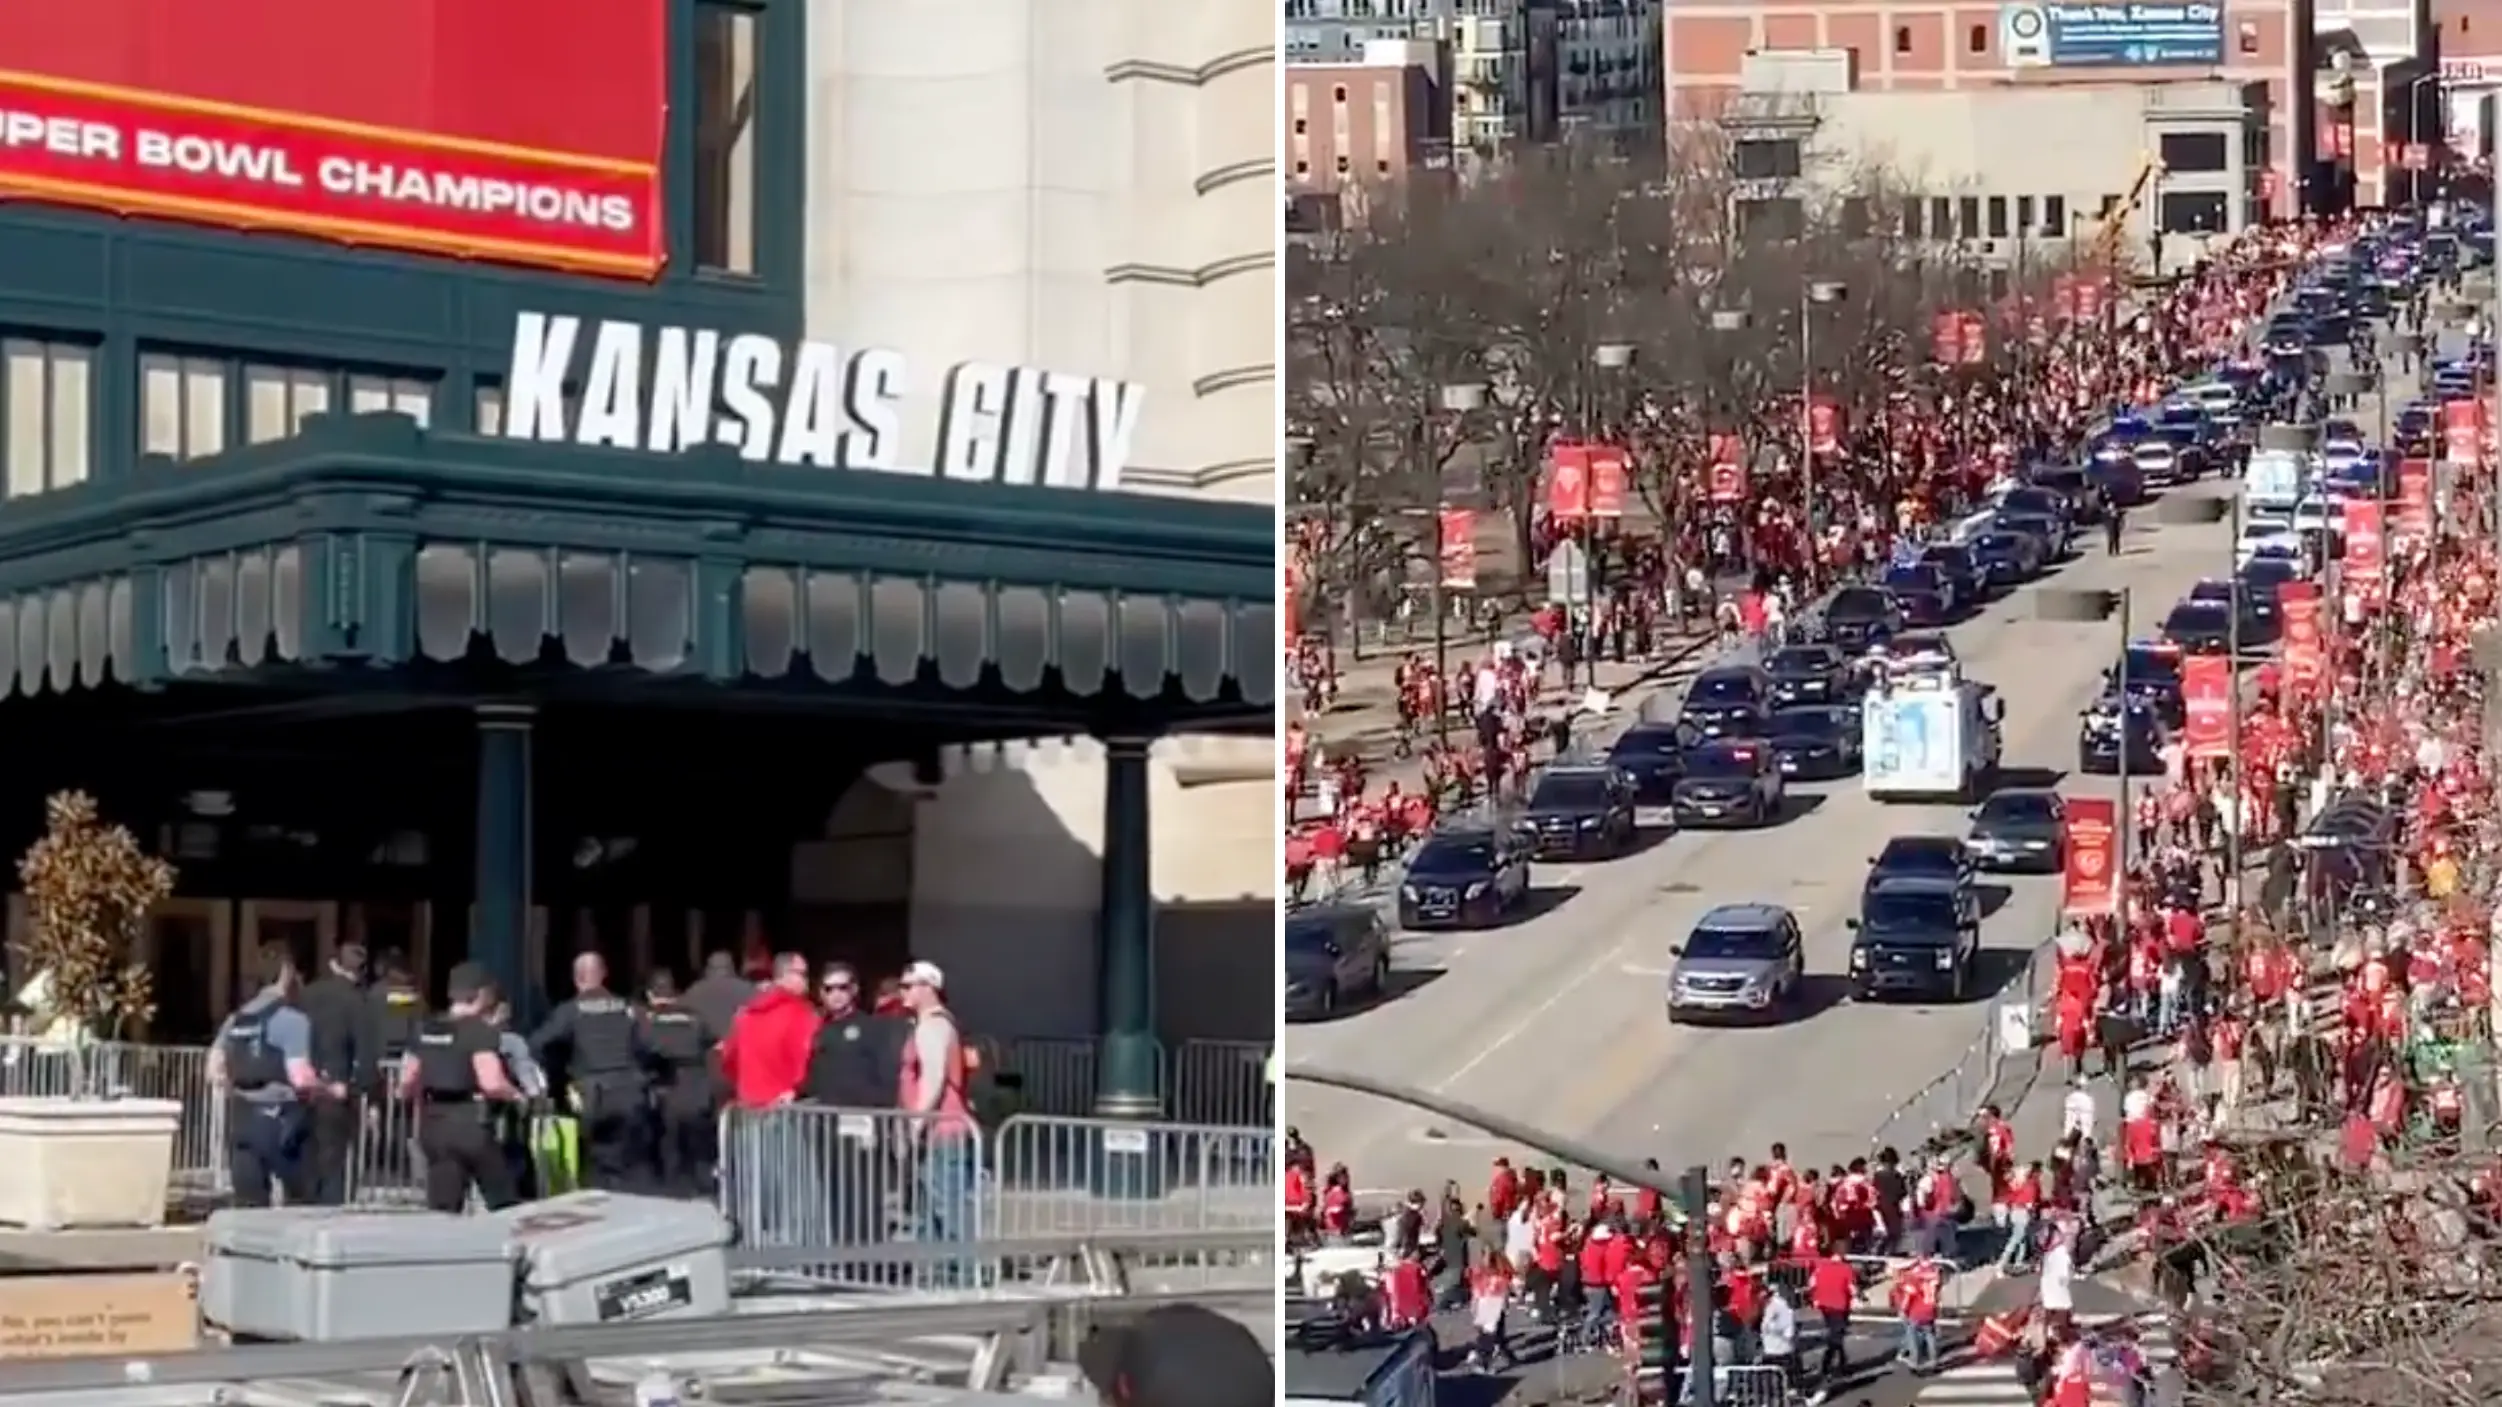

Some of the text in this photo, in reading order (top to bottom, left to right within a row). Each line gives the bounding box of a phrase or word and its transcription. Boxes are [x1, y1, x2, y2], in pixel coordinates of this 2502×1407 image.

[0, 108, 634, 231] PER BOWL CHAMPIONS
[506, 311, 1145, 490] KANSAS CITY
